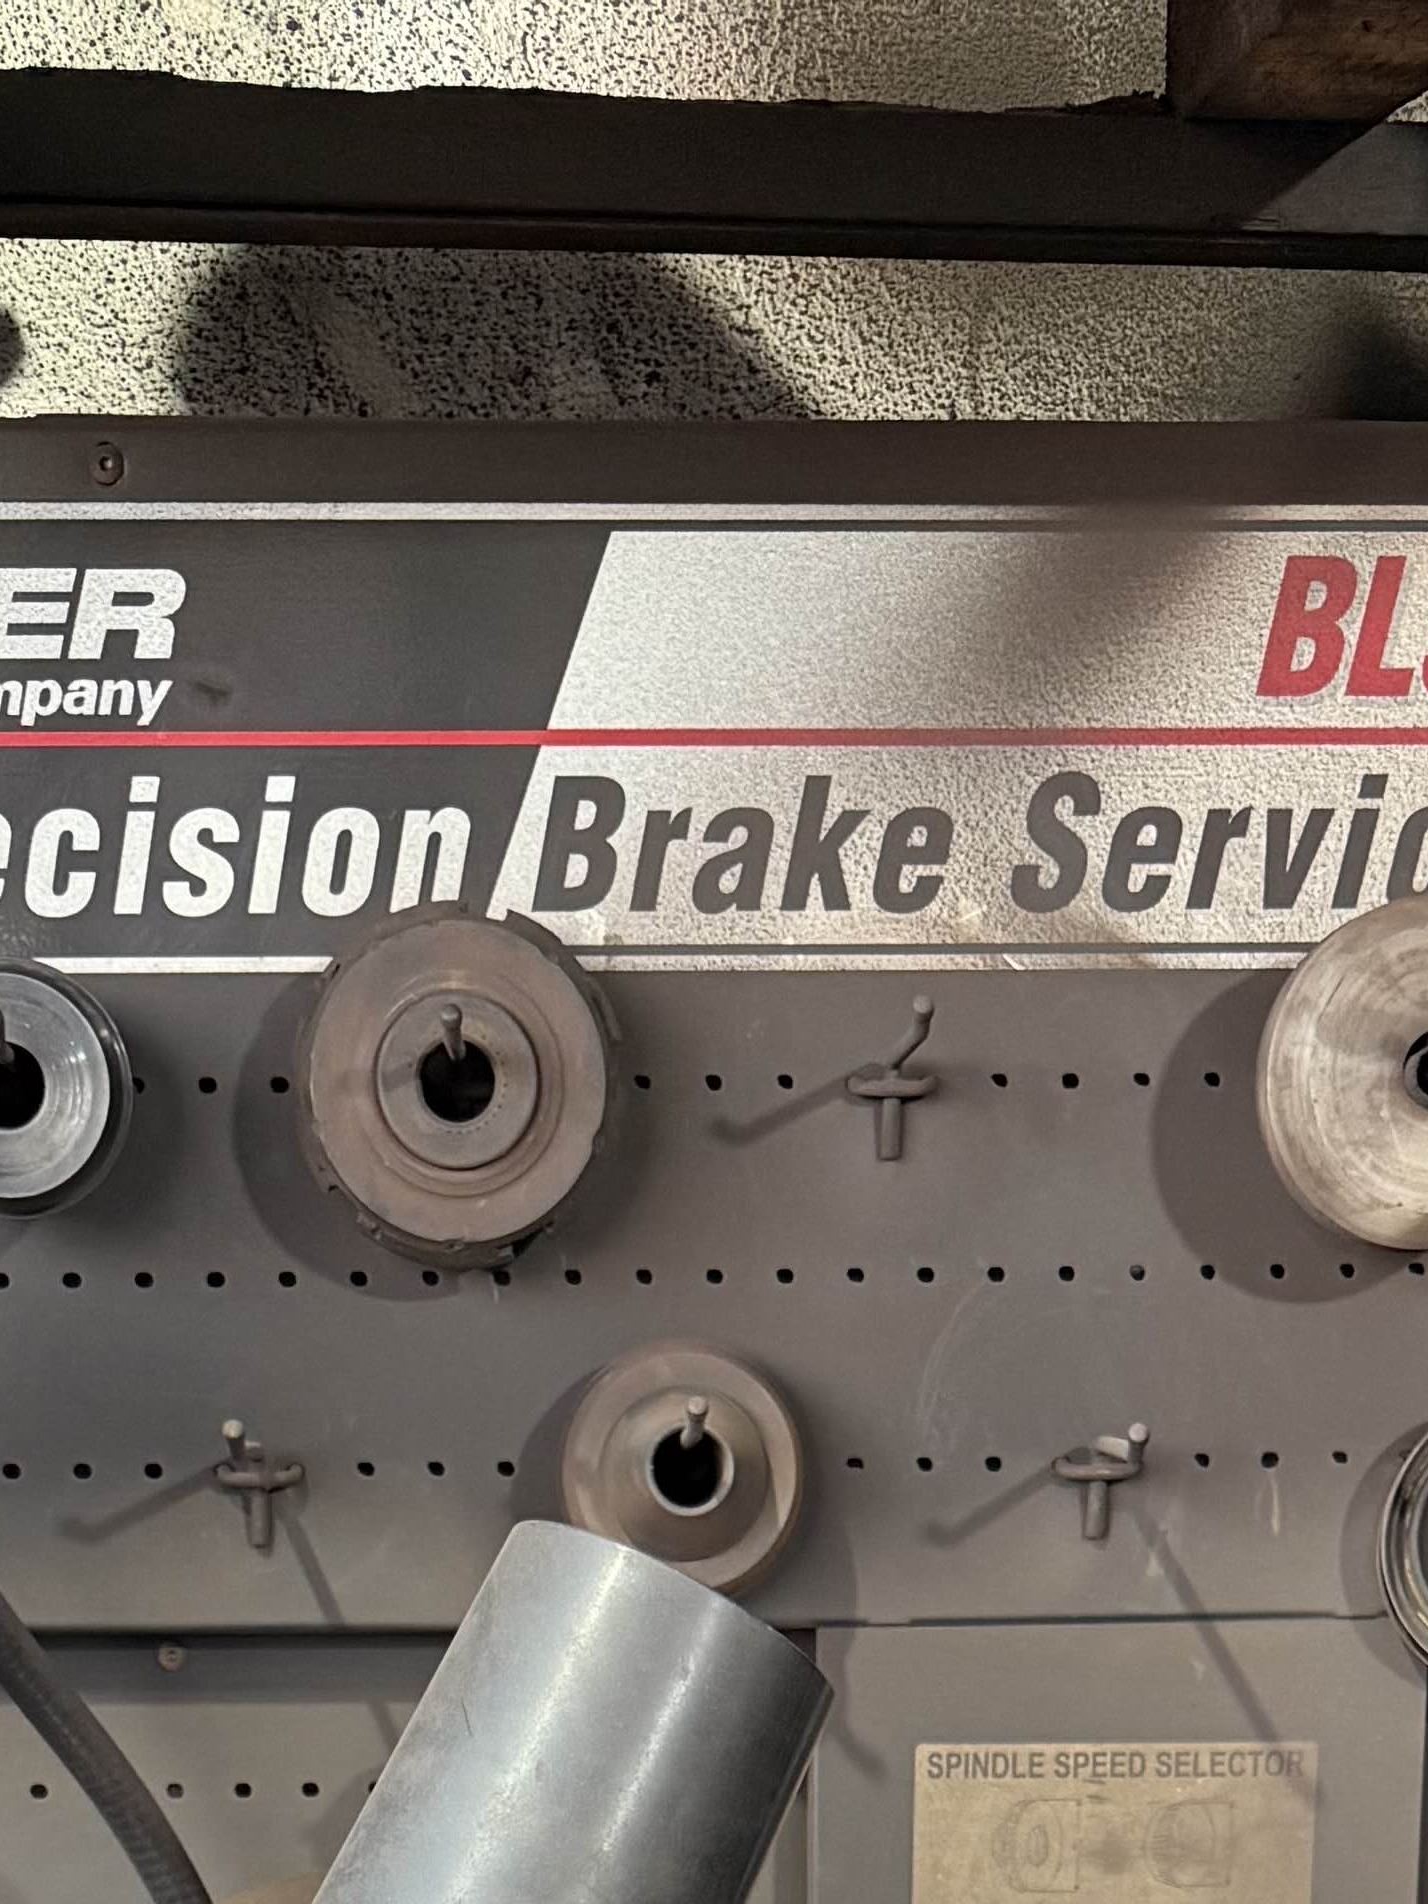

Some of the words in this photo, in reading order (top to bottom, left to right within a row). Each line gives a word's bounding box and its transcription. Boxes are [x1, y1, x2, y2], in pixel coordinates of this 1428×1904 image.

[530, 774, 957, 914] Brake
[926, 1751, 1044, 1780] SPINDLE
[1053, 1750, 1146, 1779] SPEED
[1154, 1749, 1305, 1779] SELECTOR
